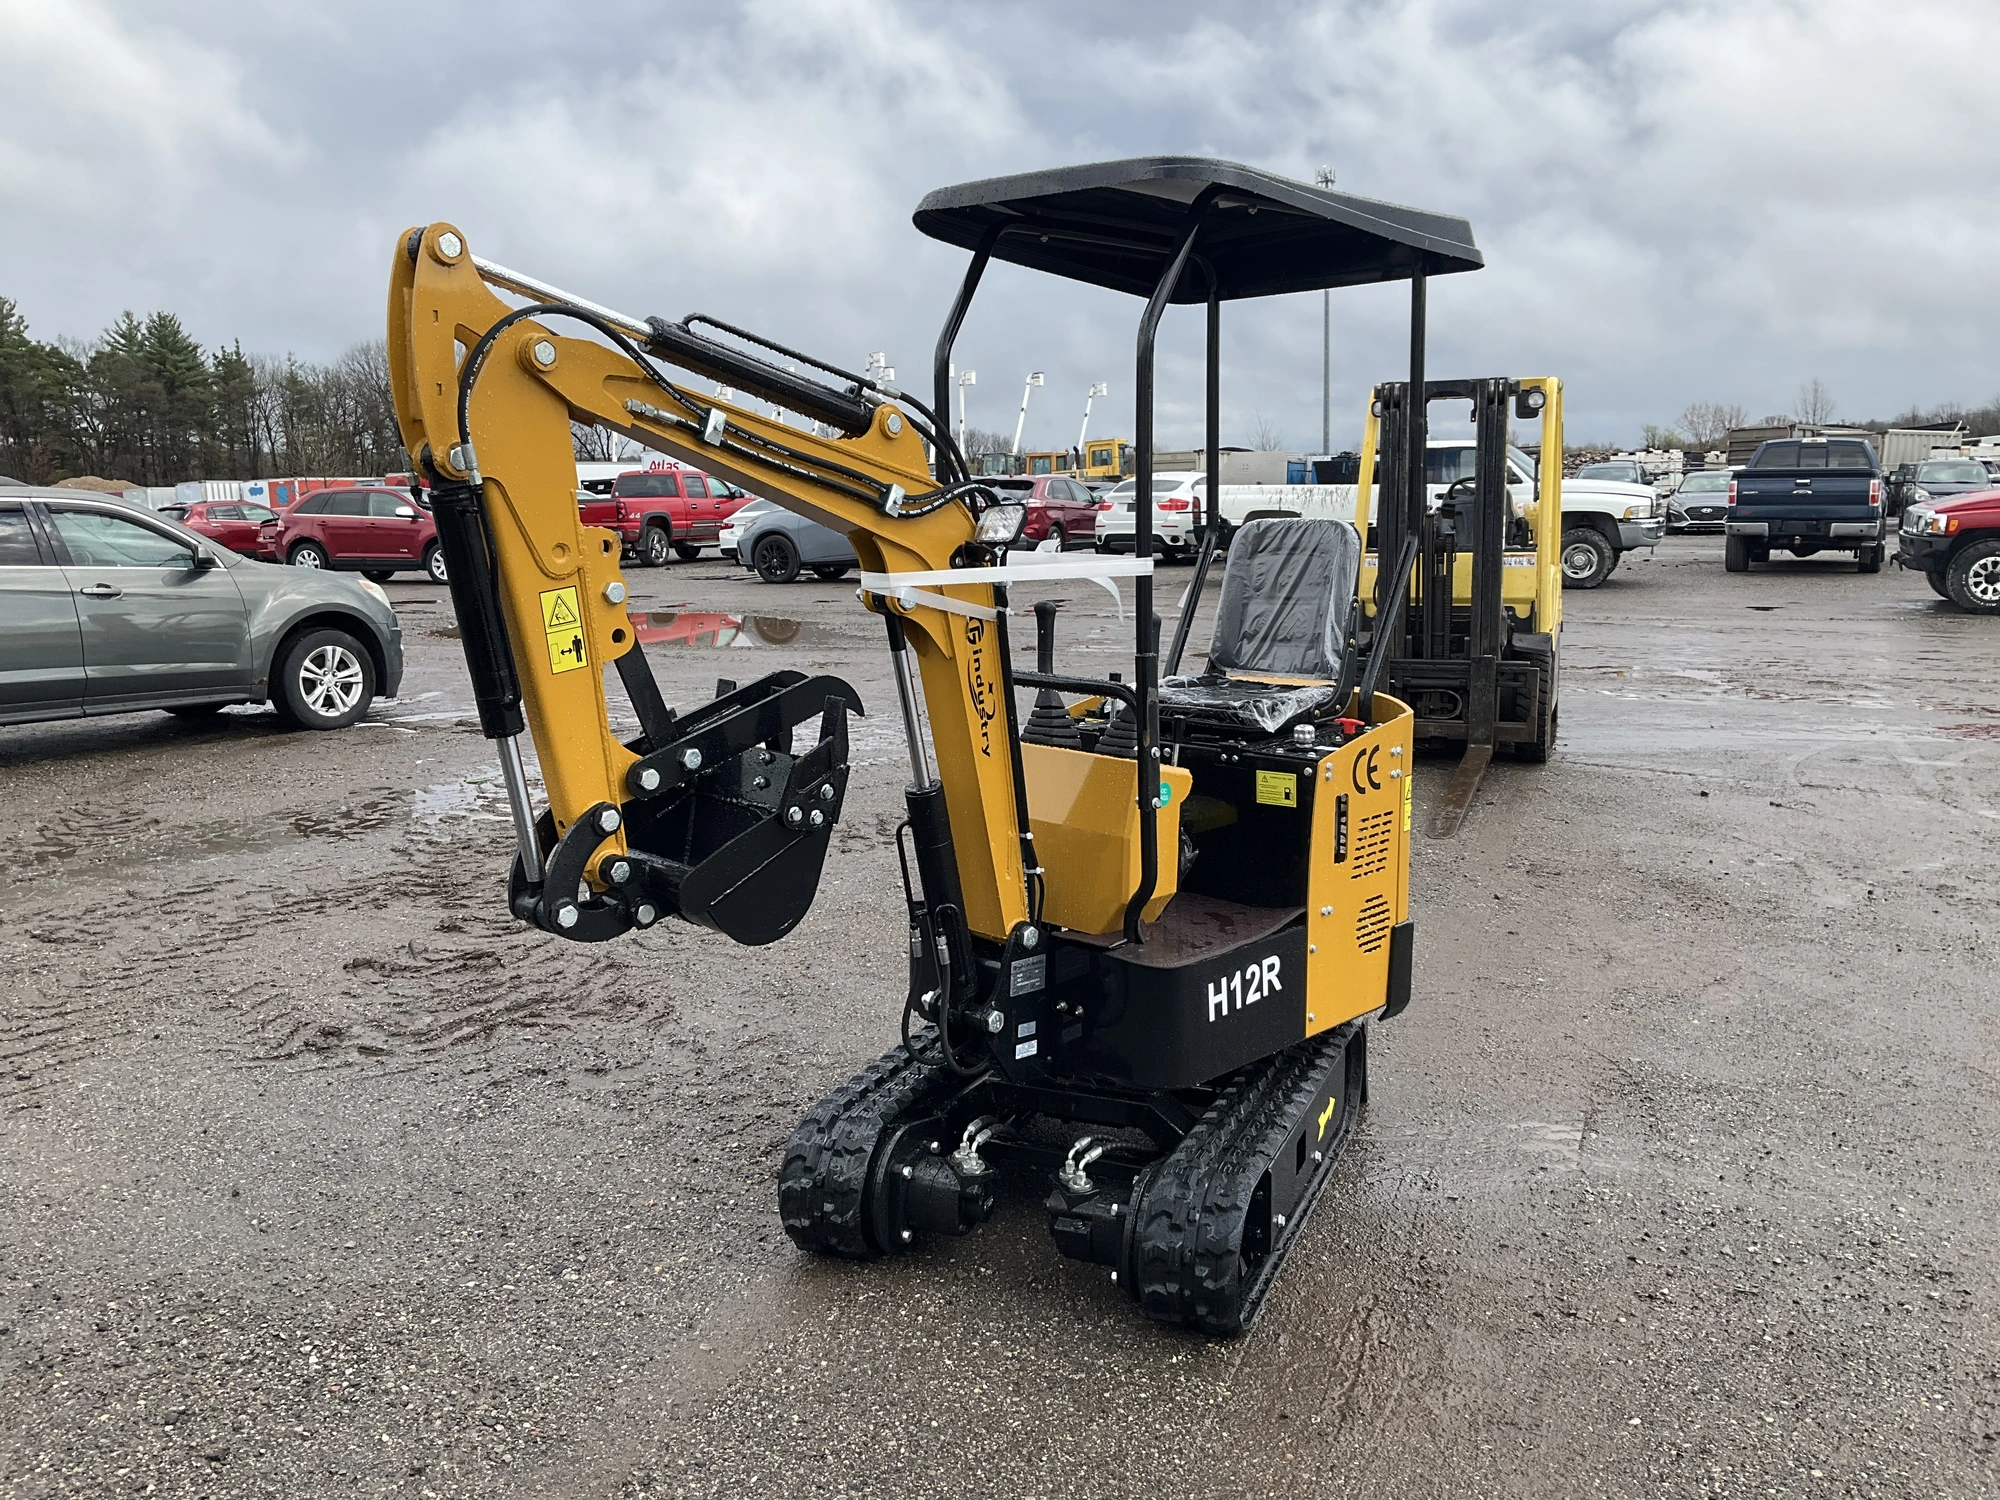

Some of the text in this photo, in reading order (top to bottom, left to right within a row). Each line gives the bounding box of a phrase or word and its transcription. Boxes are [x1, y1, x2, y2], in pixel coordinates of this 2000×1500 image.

[649, 459, 680, 470] Atlas
[1352, 744, 1381, 795] CE
[1208, 955, 1282, 1023] H12R
